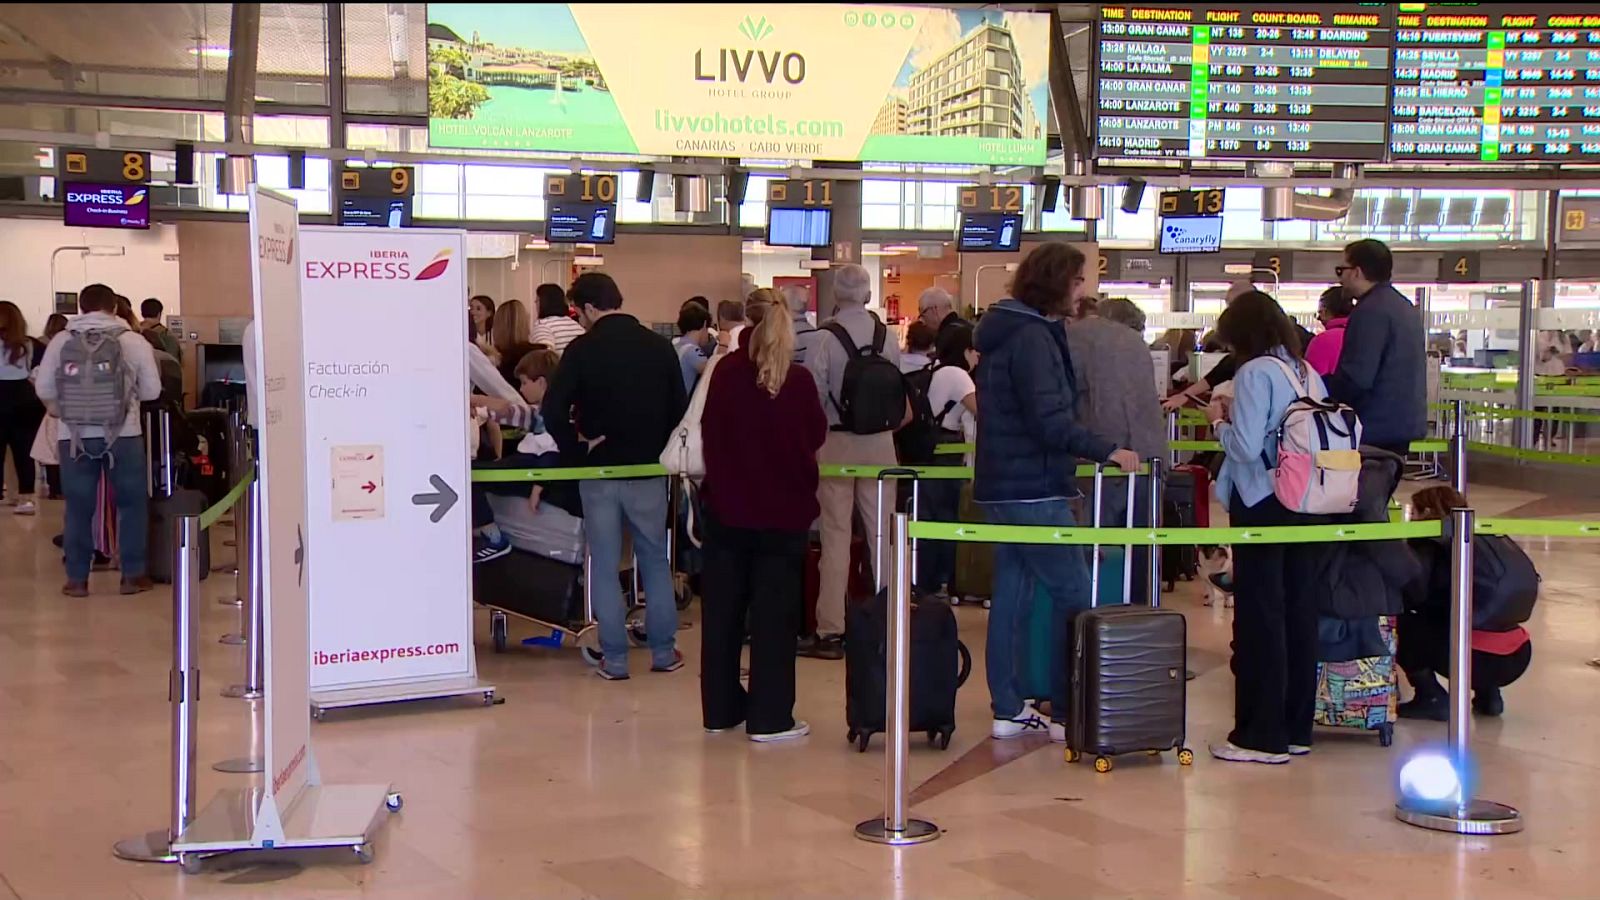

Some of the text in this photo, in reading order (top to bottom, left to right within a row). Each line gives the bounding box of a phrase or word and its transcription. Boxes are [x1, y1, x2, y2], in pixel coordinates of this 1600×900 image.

[1102, 8, 1378, 25] TIME DESTINATION FLIGHT COUNT. BOARD. REMARKS
[1398, 16, 1421, 26] TIME
[1426, 16, 1488, 27] DESTINATION
[1502, 17, 1536, 27] FLIGHT
[1102, 25, 1125, 34] 13:00
[1128, 26, 1155, 36] GRAN
[1156, 26, 1188, 37] CANAR
[1211, 28, 1224, 38] NT
[1319, 30, 1368, 41] BOARDING
[1127, 44, 1167, 55] MALAGA
[1210, 47, 1224, 57] VY
[1319, 49, 1360, 60] DELAYED
[694, 48, 806, 84] LIVVO
[1101, 62, 1124, 72] 14:00
[1126, 63, 1141, 73] LA
[1141, 63, 1171, 74] PALMA
[1210, 66, 1223, 75] NT
[708, 88, 792, 99] HOTEL GROUP
[1100, 81, 1123, 91] 14:00
[1126, 82, 1153, 92] GRAN
[1155, 82, 1186, 93] CANAR
[1209, 84, 1222, 94] NT
[1100, 100, 1123, 110] 14:00
[1125, 100, 1180, 112] LANZAROTE
[1208, 103, 1221, 113] NT
[1418, 106, 1475, 117] BARCELONA
[437, 124, 470, 136] HOTEL
[515, 127, 573, 138] LANZAROTE
[654, 109, 844, 138] livvohotels.com
[1124, 119, 1179, 131] LANZAROTE
[676, 139, 823, 155] CANARIAS CABO VERDE
[978, 143, 1005, 152] HOTEL
[1124, 138, 1160, 149] MADRID
[122, 153, 144, 180] 8
[391, 168, 409, 194] 9
[580, 175, 615, 201] 10
[67, 192, 124, 205] EXPRESS
[803, 181, 833, 205] 11
[990, 187, 1020, 210] 12
[1193, 190, 1222, 213] 13
[1174, 235, 1217, 245] canaryfly
[370, 250, 409, 259] IBERIA
[306, 261, 411, 280] EXPRESS
[1098, 256, 1108, 274] 2
[1269, 256, 1281, 275] 3
[1454, 256, 1468, 276] 4
[308, 361, 390, 376] Facturación
[309, 383, 367, 399] Check-in
[313, 642, 460, 667] iberiaexpress.com
